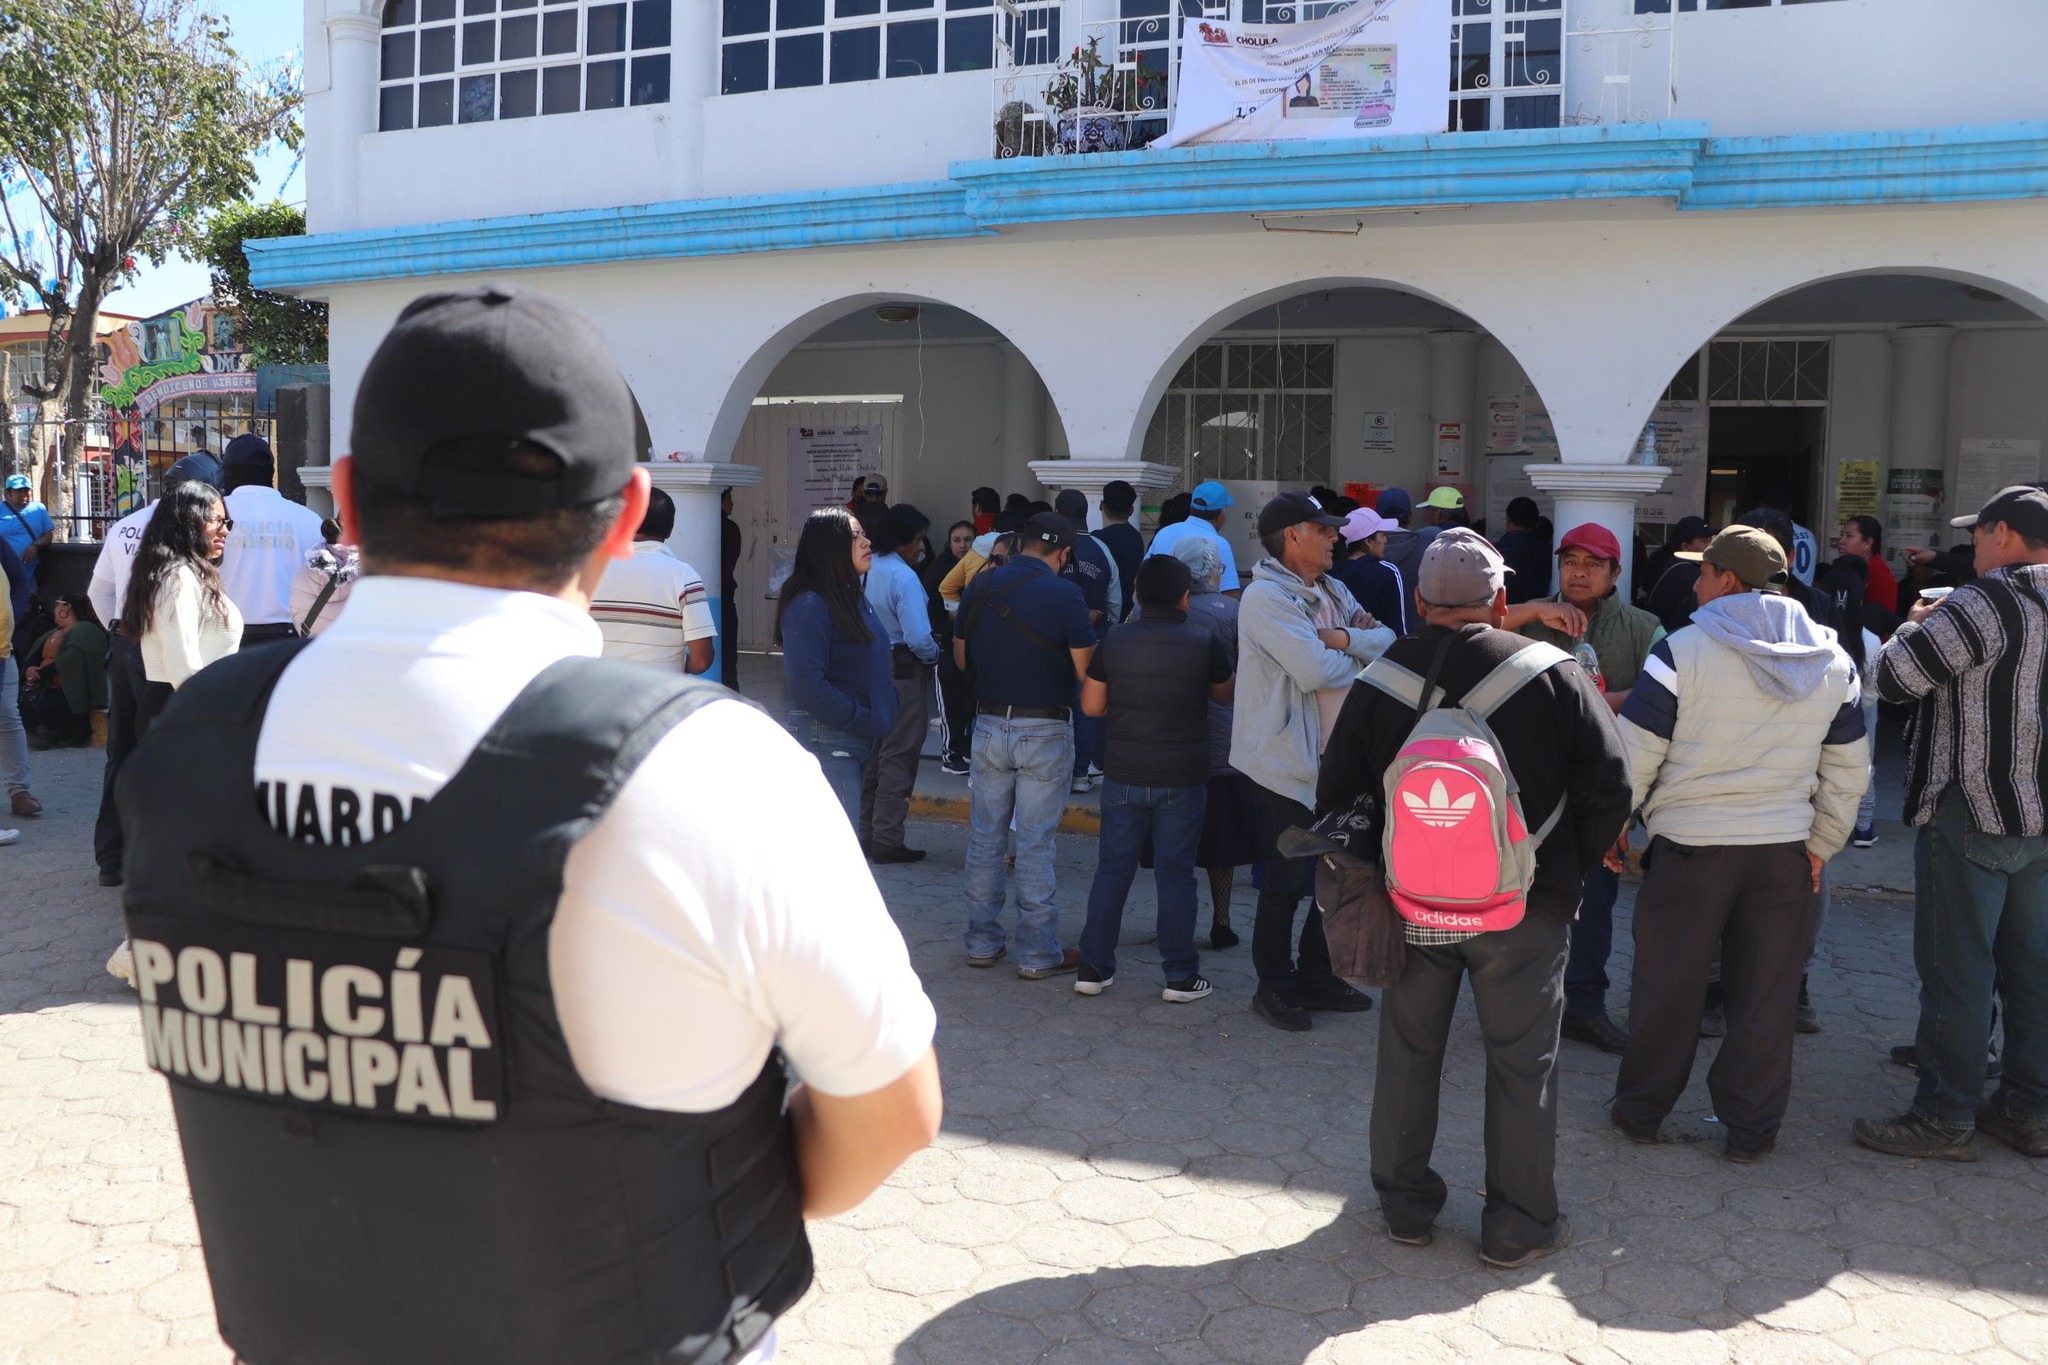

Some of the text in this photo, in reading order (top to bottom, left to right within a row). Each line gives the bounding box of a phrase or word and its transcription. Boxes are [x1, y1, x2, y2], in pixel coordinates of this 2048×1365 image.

[1236, 36, 1279, 47] CHOLULA
[1305, 38, 1323, 49] PEDRO
[1323, 28, 1349, 43] CHOLULA
[1311, 46, 1324, 58] SAN
[1078, 560, 1103, 580] YORK
[254, 780, 430, 848] UARD
[1414, 910, 1484, 927] adidas
[131, 938, 492, 1050] POLICÍA
[143, 1003, 497, 1121] MUNICIPAL
